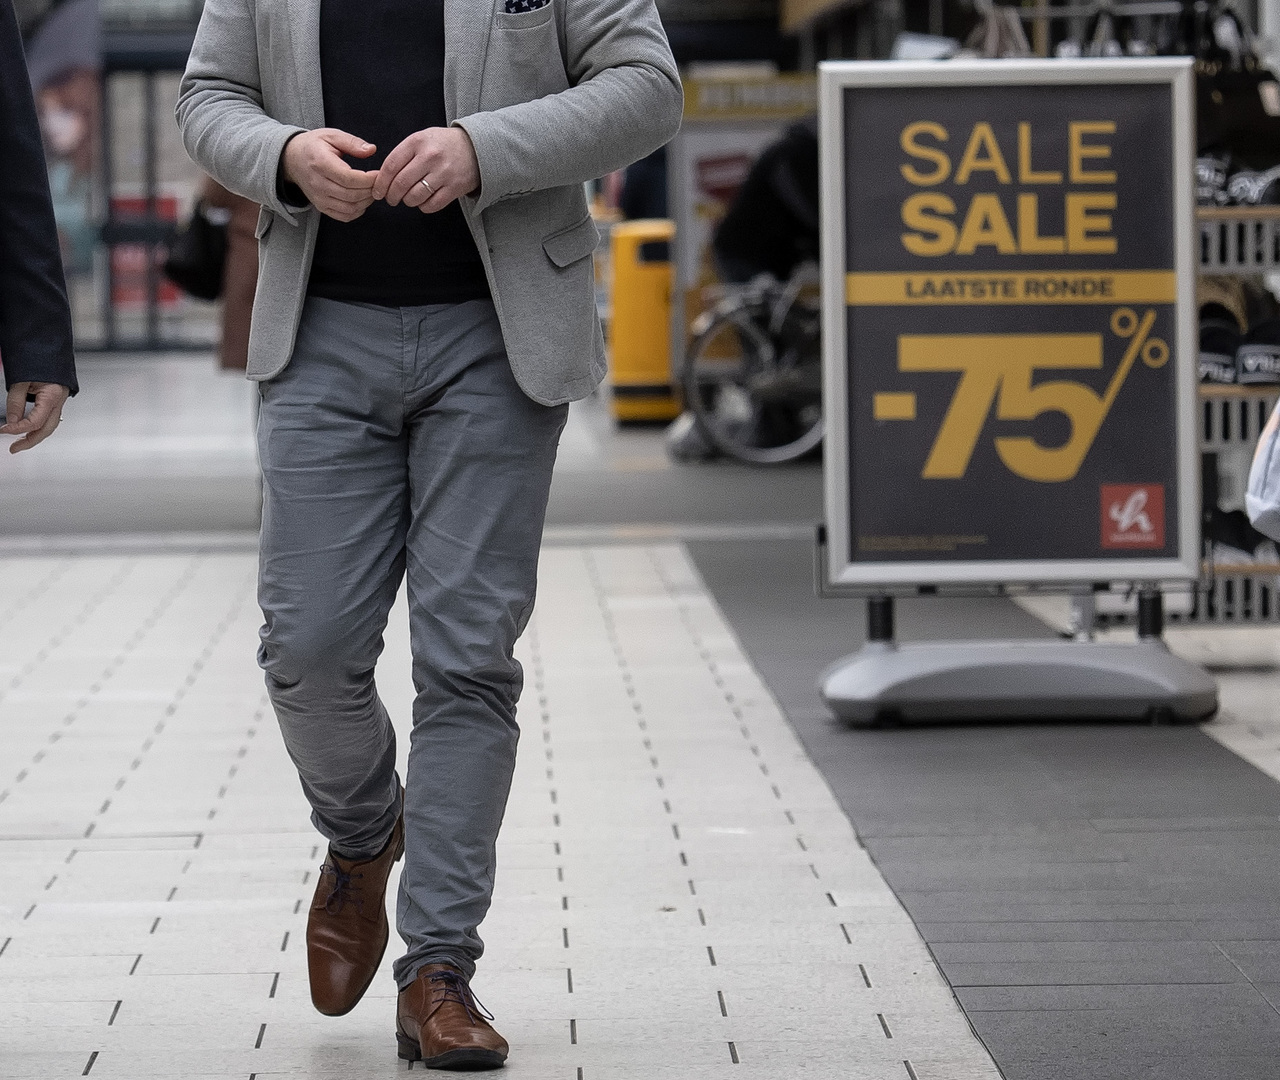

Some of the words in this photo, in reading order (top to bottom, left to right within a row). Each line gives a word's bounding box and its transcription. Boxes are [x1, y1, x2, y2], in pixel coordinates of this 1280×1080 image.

[899, 120, 1119, 187] SALE
[899, 191, 1119, 257] SALE
[904, 279, 1018, 299] LAATSTE
[1024, 277, 1114, 298] RONDE
[873, 307, 1171, 484] -75%
